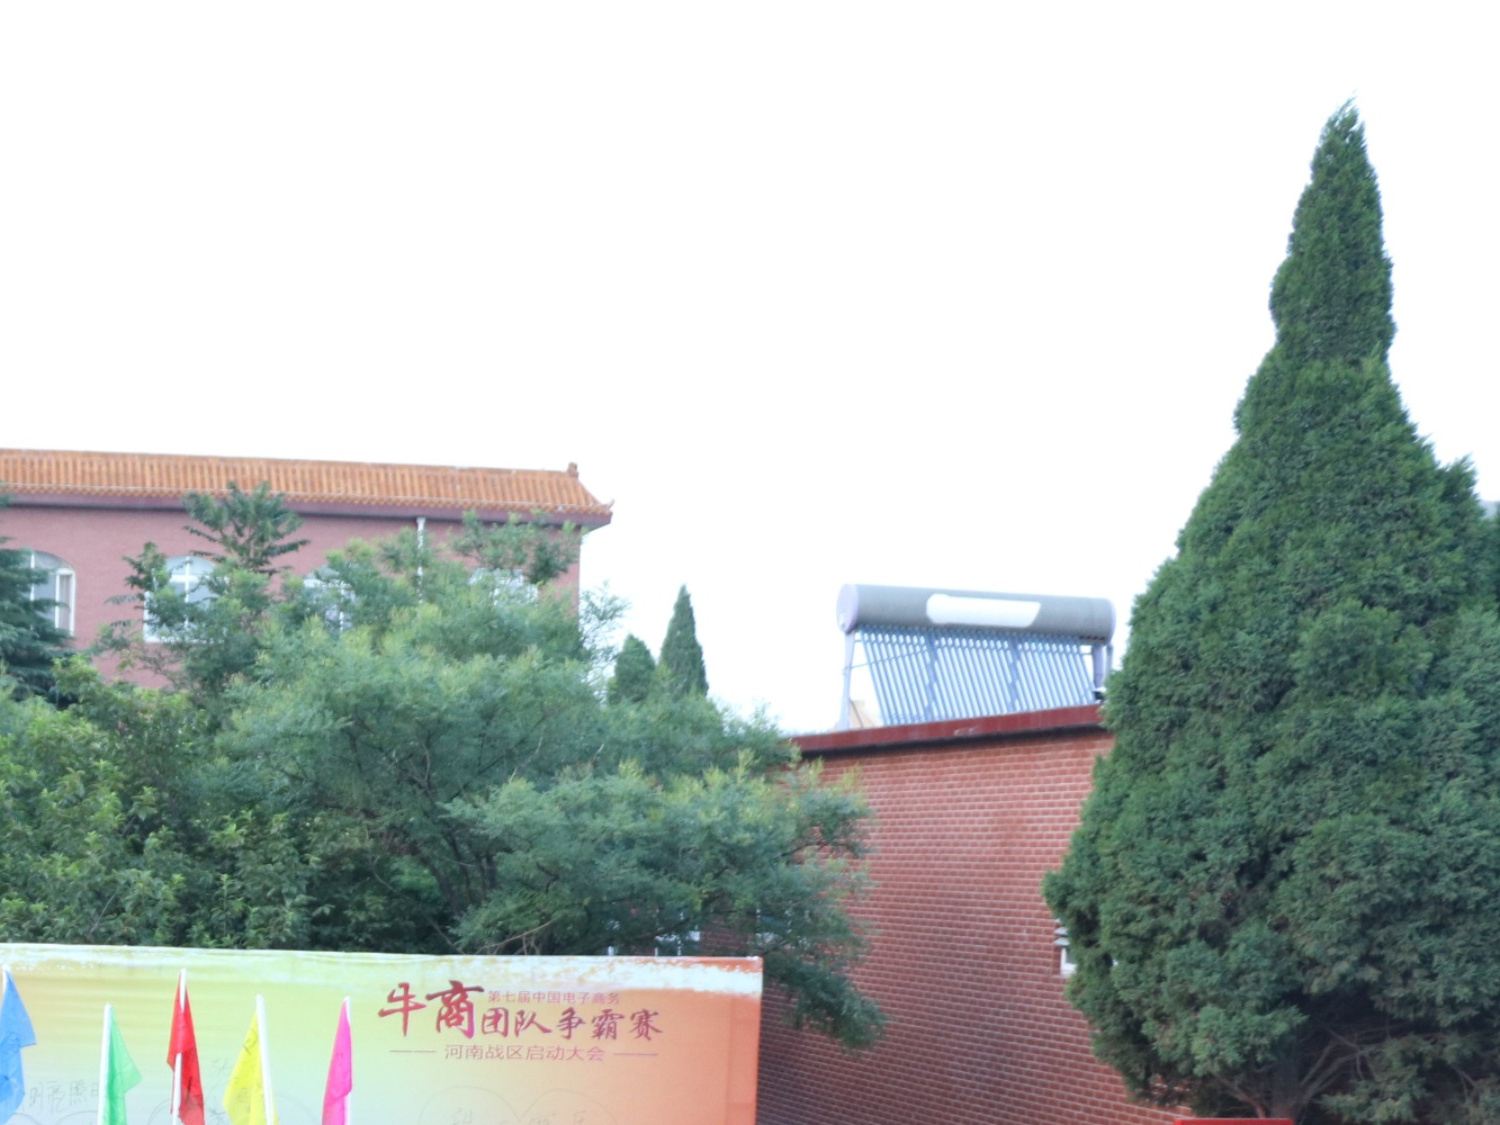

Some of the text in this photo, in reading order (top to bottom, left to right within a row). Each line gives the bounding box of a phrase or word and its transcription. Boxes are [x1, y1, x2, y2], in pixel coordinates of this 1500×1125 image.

[444, 1044, 605, 1062] 河南战区启动大会
